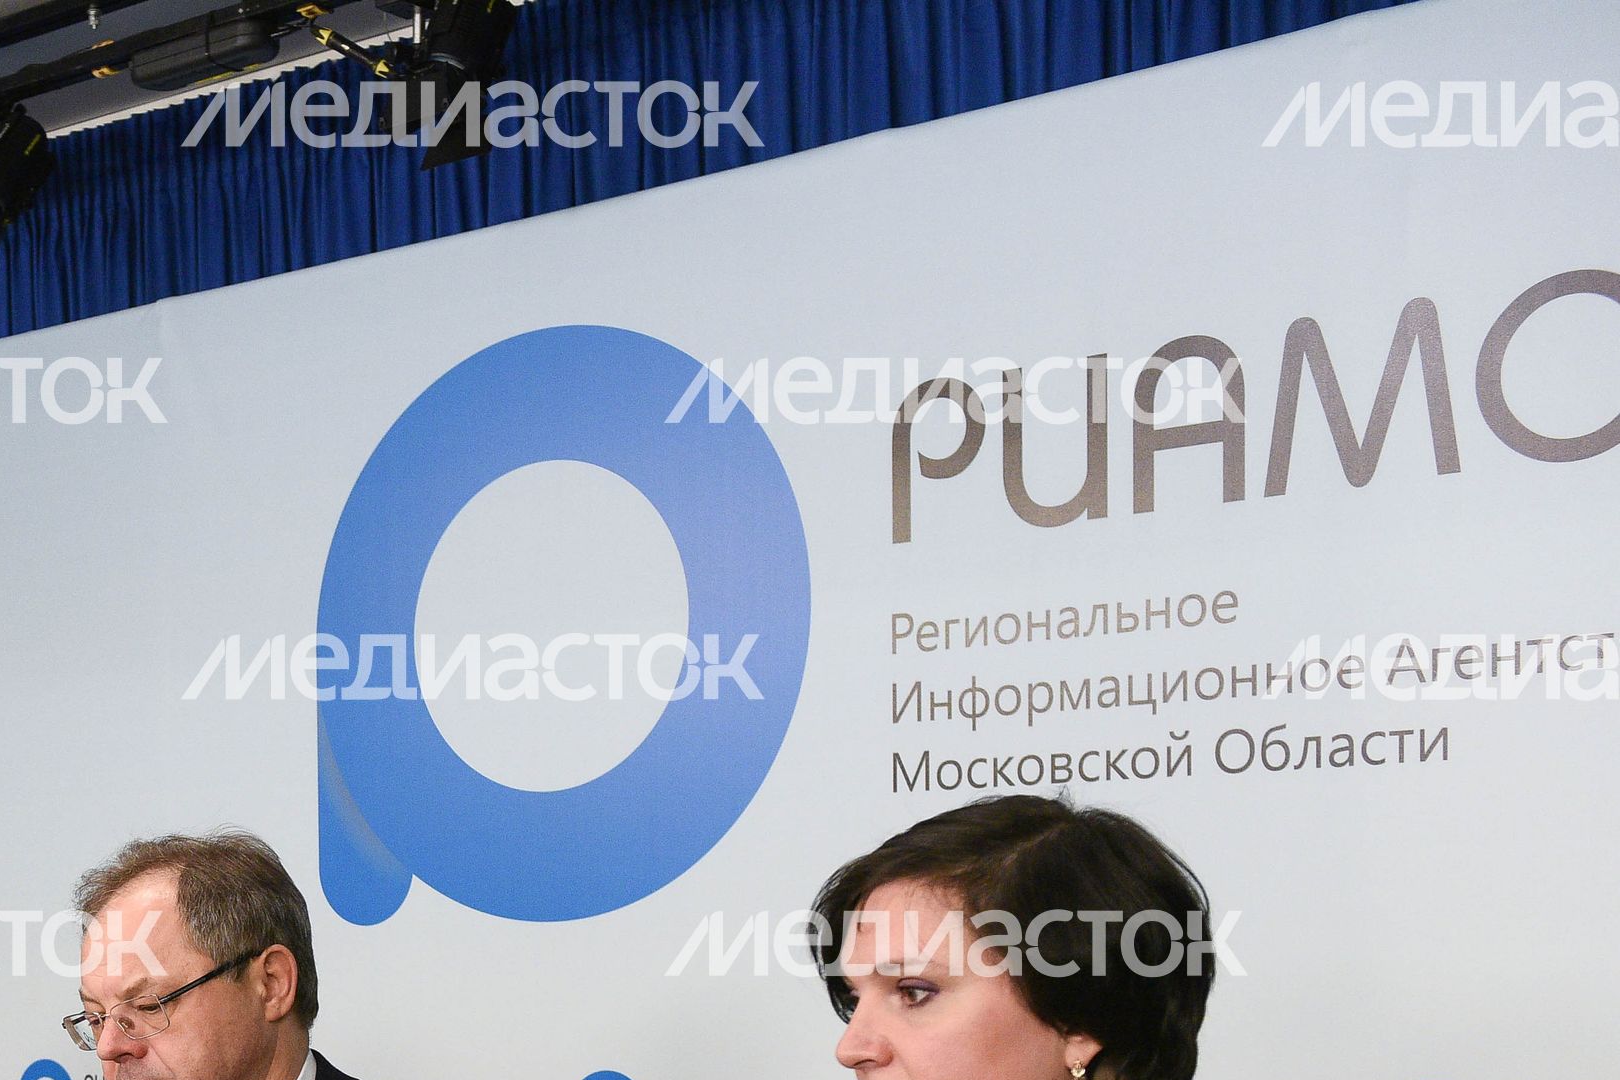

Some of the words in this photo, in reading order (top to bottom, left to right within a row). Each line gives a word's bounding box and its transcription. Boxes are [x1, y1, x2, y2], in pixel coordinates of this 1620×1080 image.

[892, 268, 1620, 545] РИАМО
[891, 588, 1240, 655] Региональное
[891, 652, 1366, 732] Информационное
[1385, 632, 1615, 687] Агентст
[891, 729, 1193, 794] Московской
[1214, 723, 1450, 776] Области
